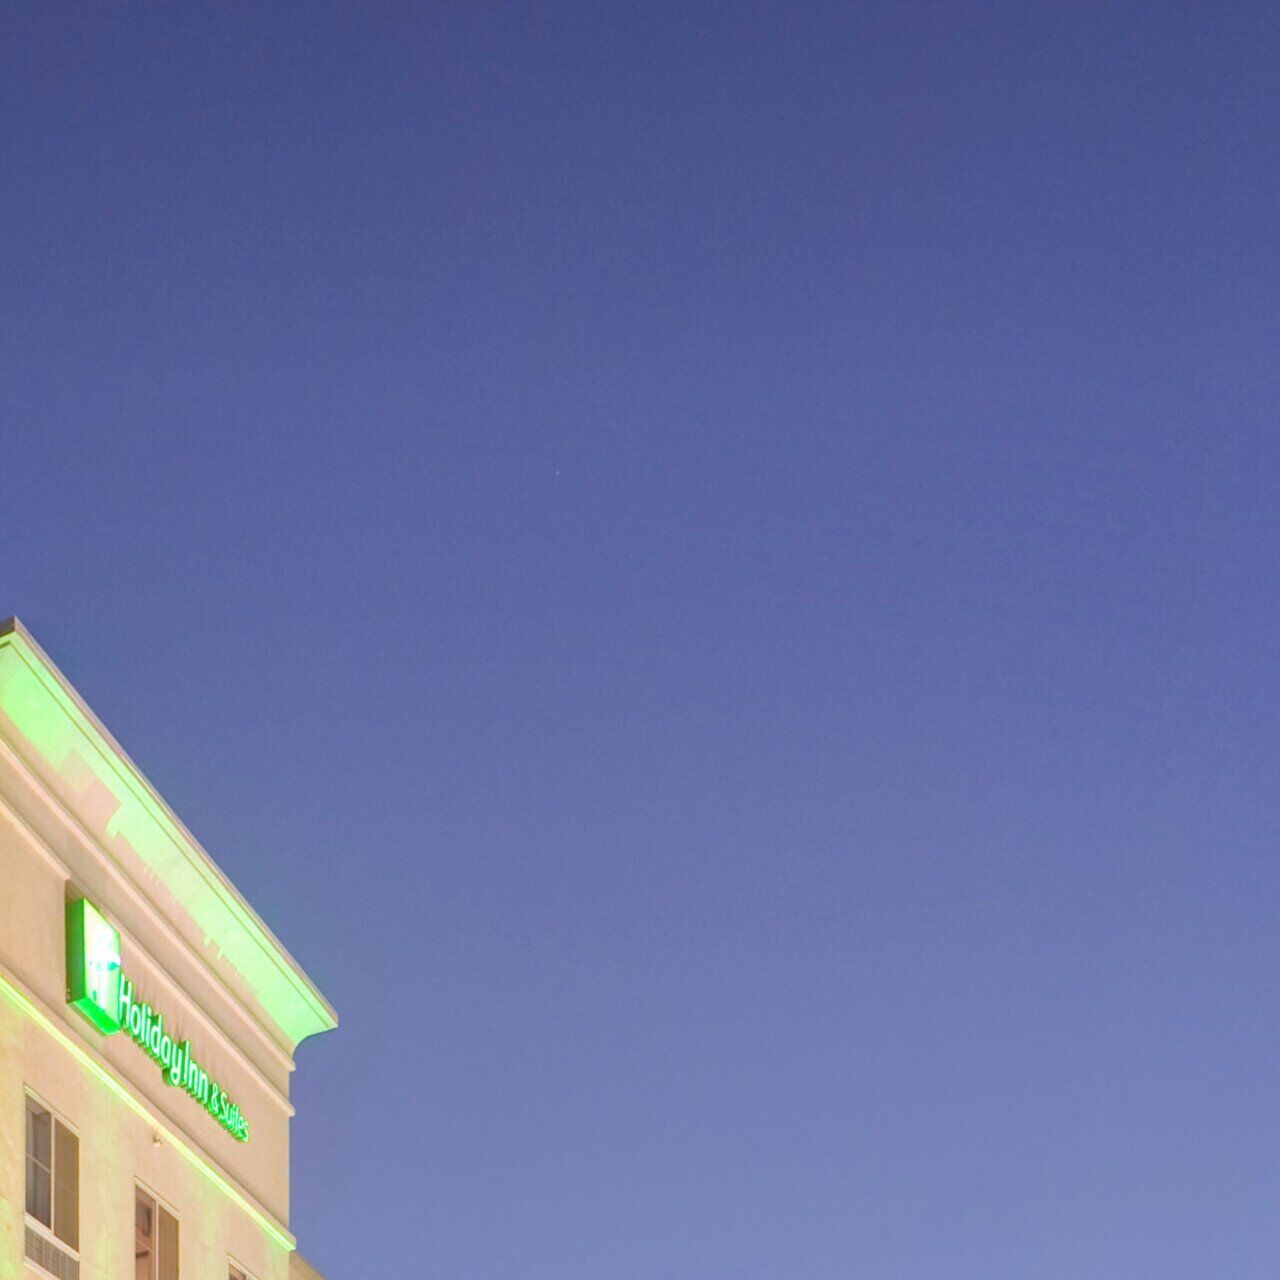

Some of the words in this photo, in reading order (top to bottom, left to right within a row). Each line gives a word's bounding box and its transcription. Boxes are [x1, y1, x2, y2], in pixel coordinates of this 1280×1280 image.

[119, 972, 182, 1087] Holiday
[183, 1040, 209, 1104] Inn
[211, 1082, 220, 1114] &
[220, 1091, 250, 1142] Suites
